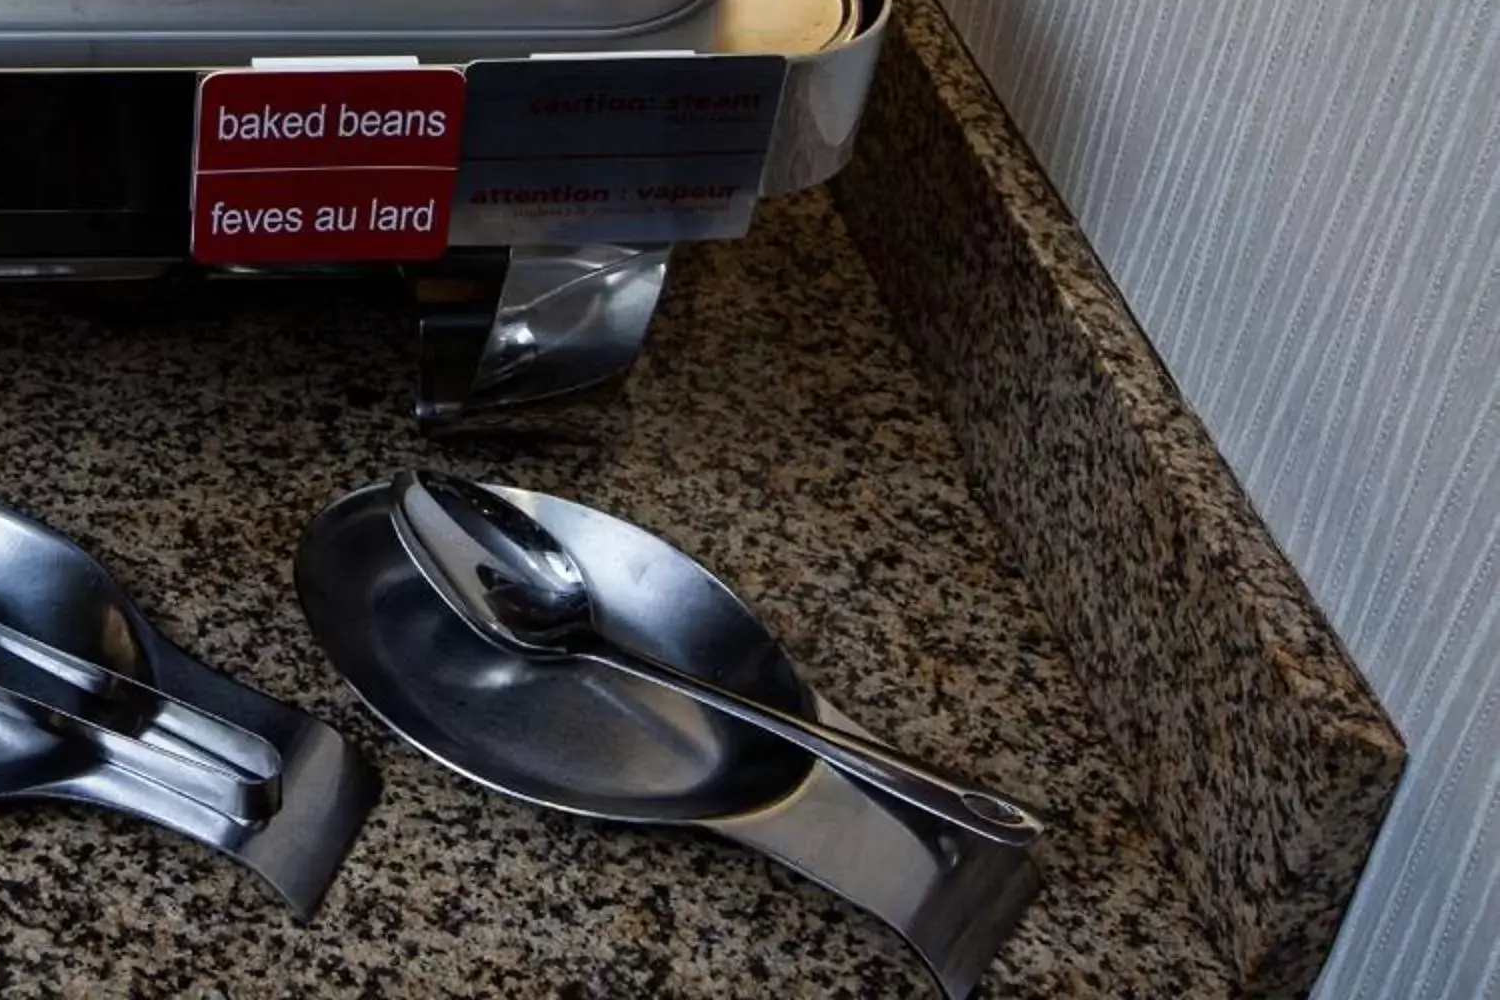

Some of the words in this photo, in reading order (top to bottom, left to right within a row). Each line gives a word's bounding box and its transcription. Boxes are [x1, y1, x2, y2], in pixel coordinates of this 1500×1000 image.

[218, 103, 327, 141] baked
[338, 103, 446, 138] beans
[471, 184, 609, 205] attention
[210, 201, 303, 236] feves
[314, 206, 356, 233] au
[368, 197, 435, 232] lard
